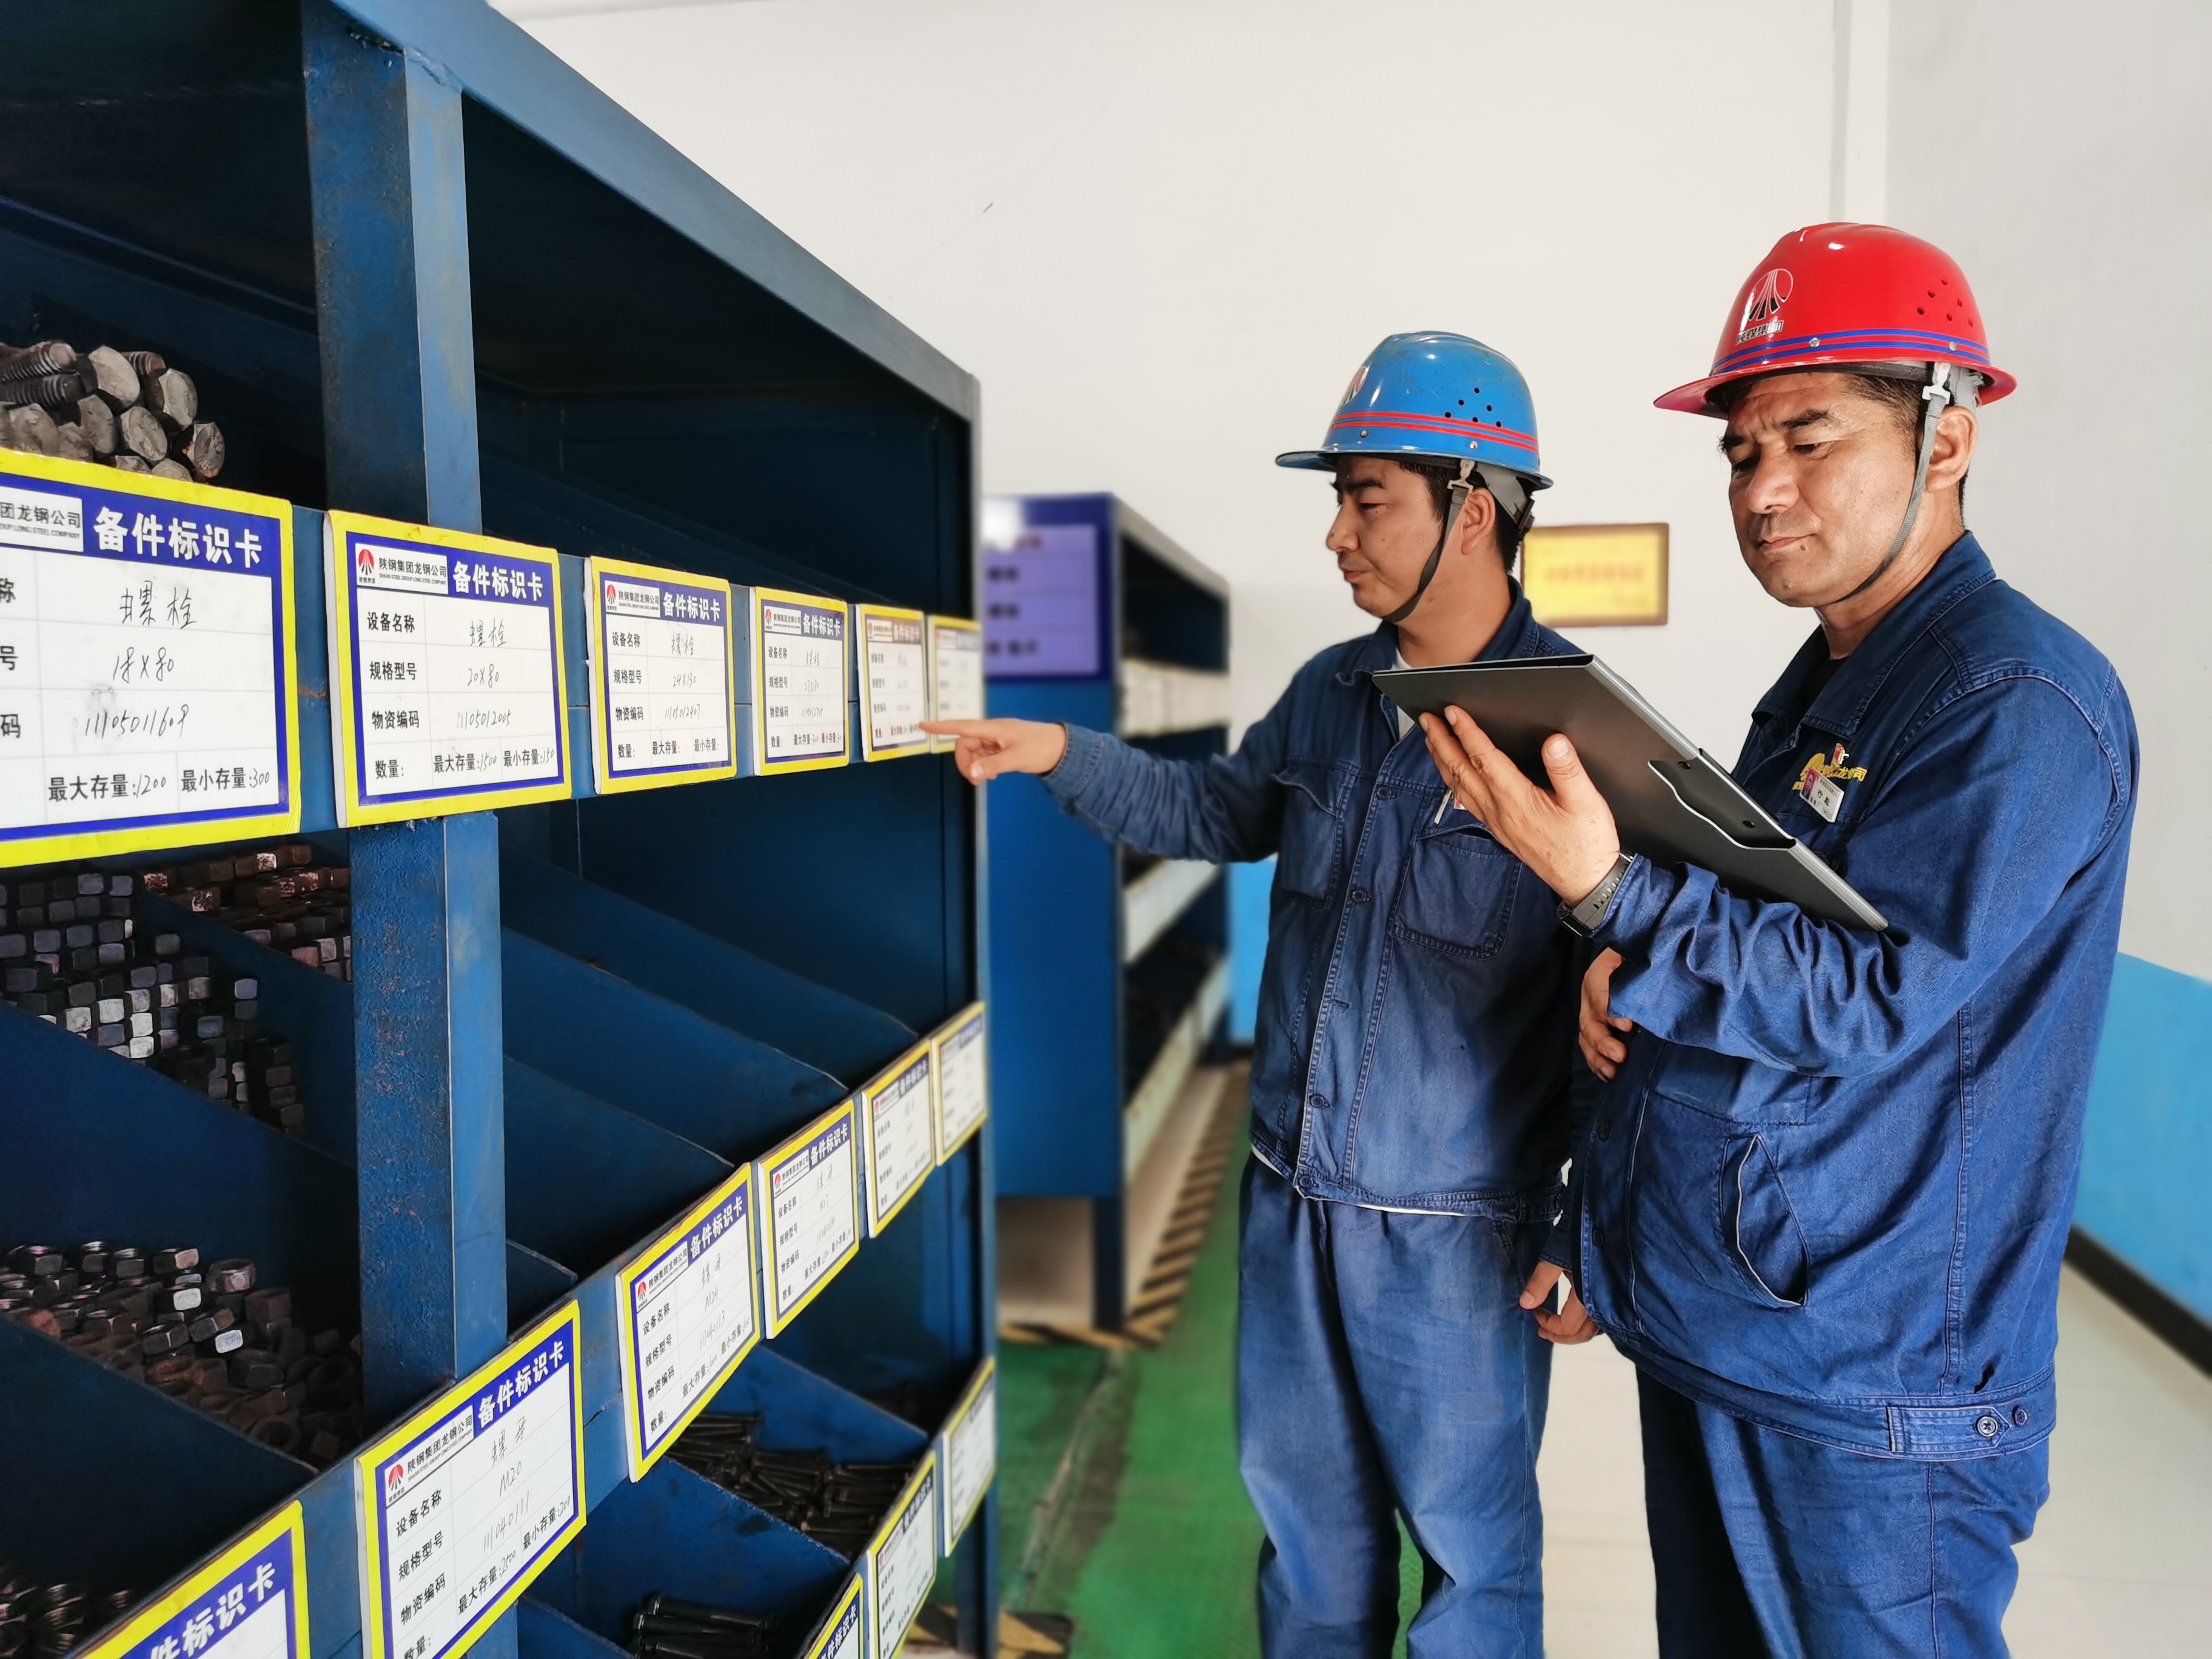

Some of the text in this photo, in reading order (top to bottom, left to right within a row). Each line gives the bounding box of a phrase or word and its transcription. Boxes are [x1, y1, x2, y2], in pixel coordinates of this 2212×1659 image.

[93, 506, 262, 568] 备件标识卡
[379, 557, 446, 577] 陕钢集团龙钢公司
[452, 561, 543, 602] 备件标识卡
[367, 611, 415, 633] 设备名称
[663, 592, 720, 622] 备件标识卡
[803, 613, 841, 637] 备件标识卡
[612, 631, 641, 648] 设备名称
[369, 661, 417, 681] 规格型号
[614, 669, 642, 684] 规格型号
[371, 710, 420, 730] 物资编码
[615, 706, 644, 722] 物资编码
[810, 1123, 848, 1166] 备件标识卡
[690, 1196, 743, 1259] 备件标识卡
[643, 1302, 671, 1336] 设备名称
[645, 1333, 672, 1369] 规格型号
[477, 1341, 565, 1429] 备件标识卡
[648, 1364, 675, 1402] 物资编码
[407, 1414, 472, 1475] 陕钢集团龙钢公司
[396, 1489, 442, 1538] 设备名称
[398, 1530, 444, 1582] 规格型号
[400, 1572, 446, 1626] 物资编码
